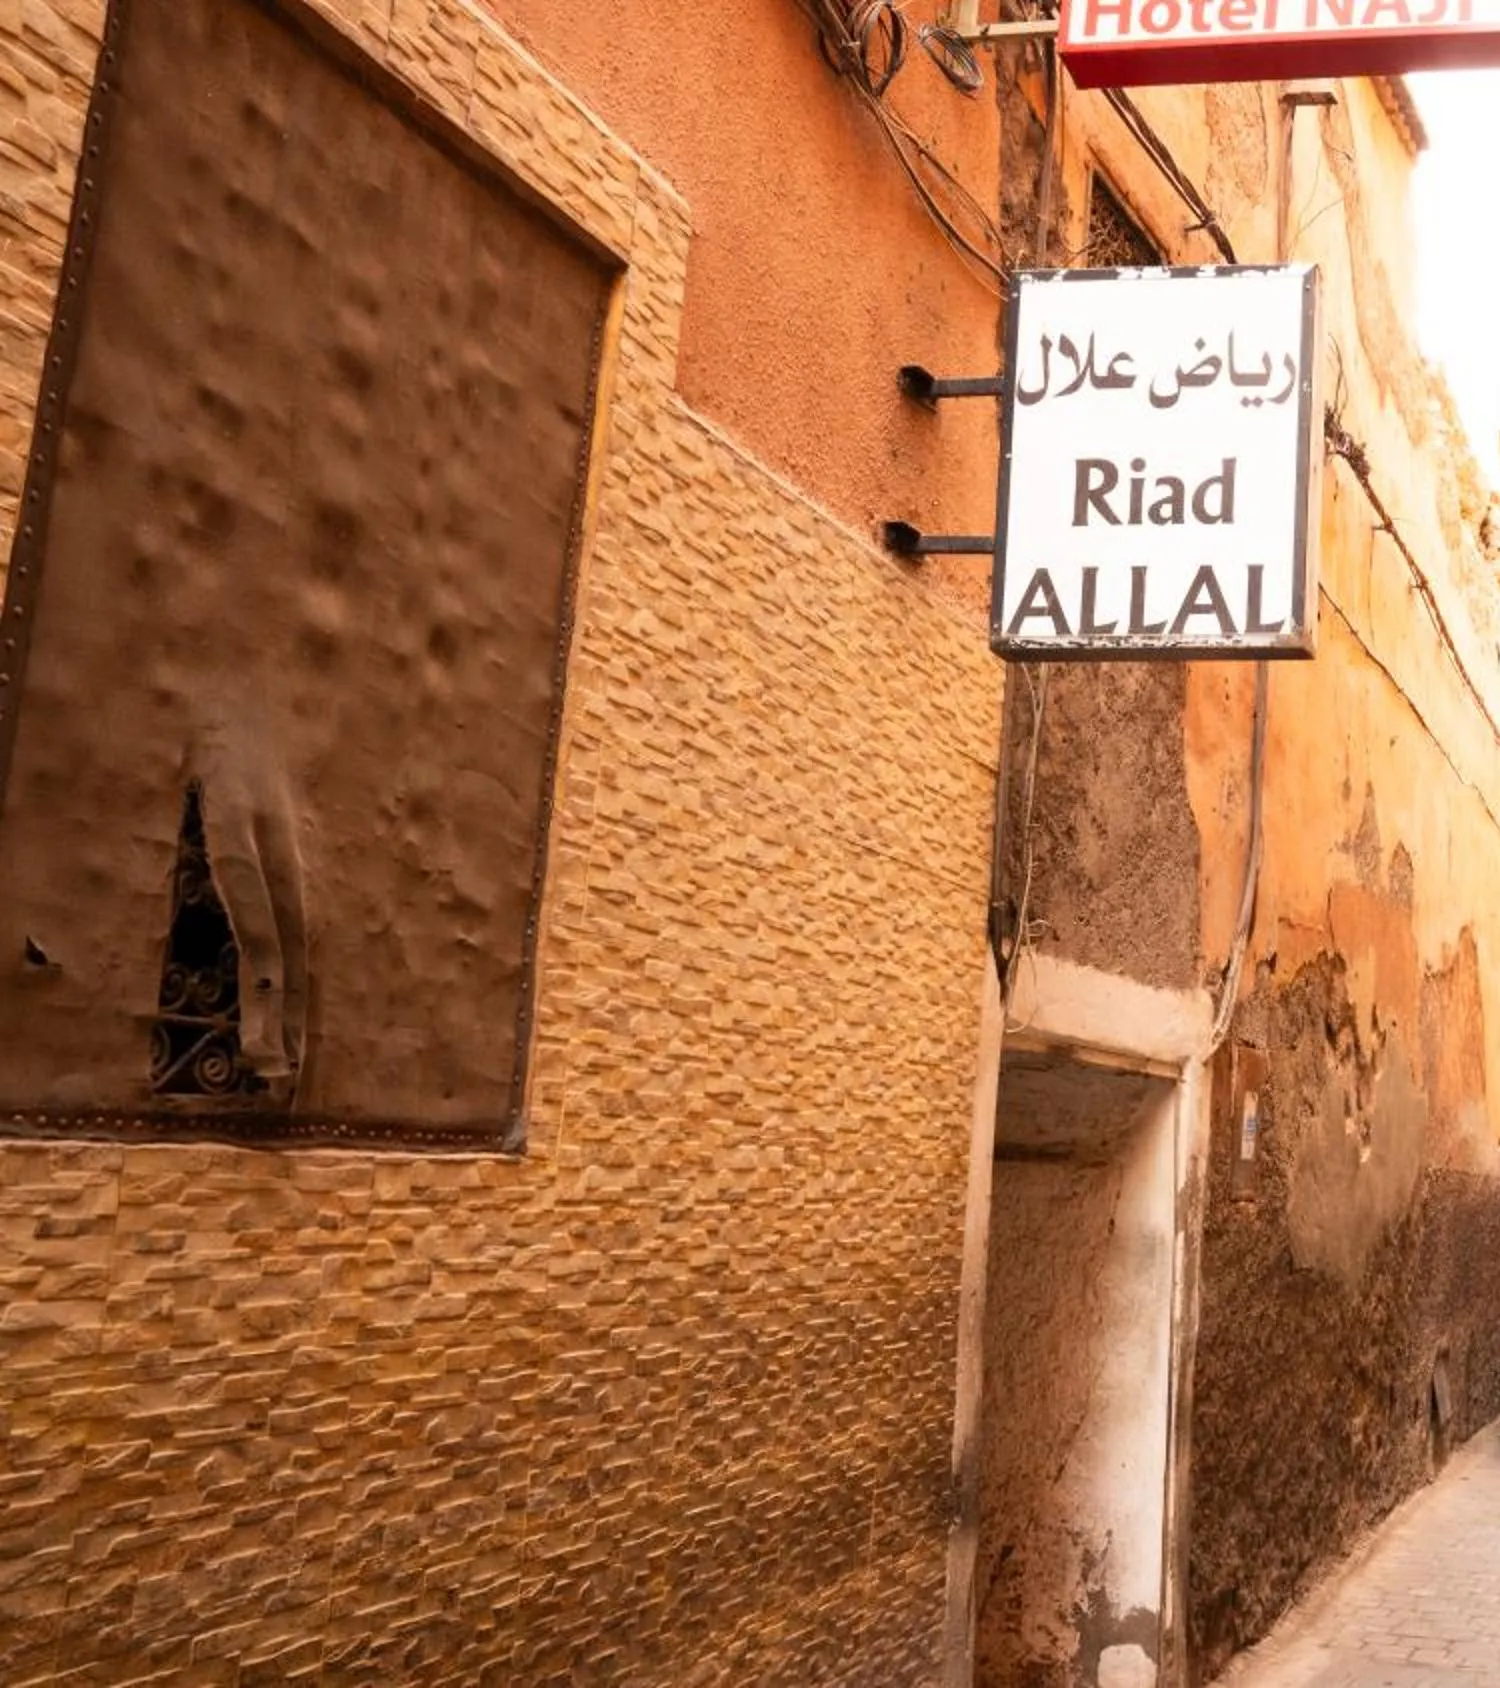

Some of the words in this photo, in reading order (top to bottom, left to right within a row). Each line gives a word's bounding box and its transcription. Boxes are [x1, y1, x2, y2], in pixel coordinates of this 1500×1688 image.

[1015, 330, 1138, 407] علال
[1149, 327, 1297, 409] رياض
[1071, 457, 1238, 527] Riad
[1006, 564, 1286, 635] ALLAL
